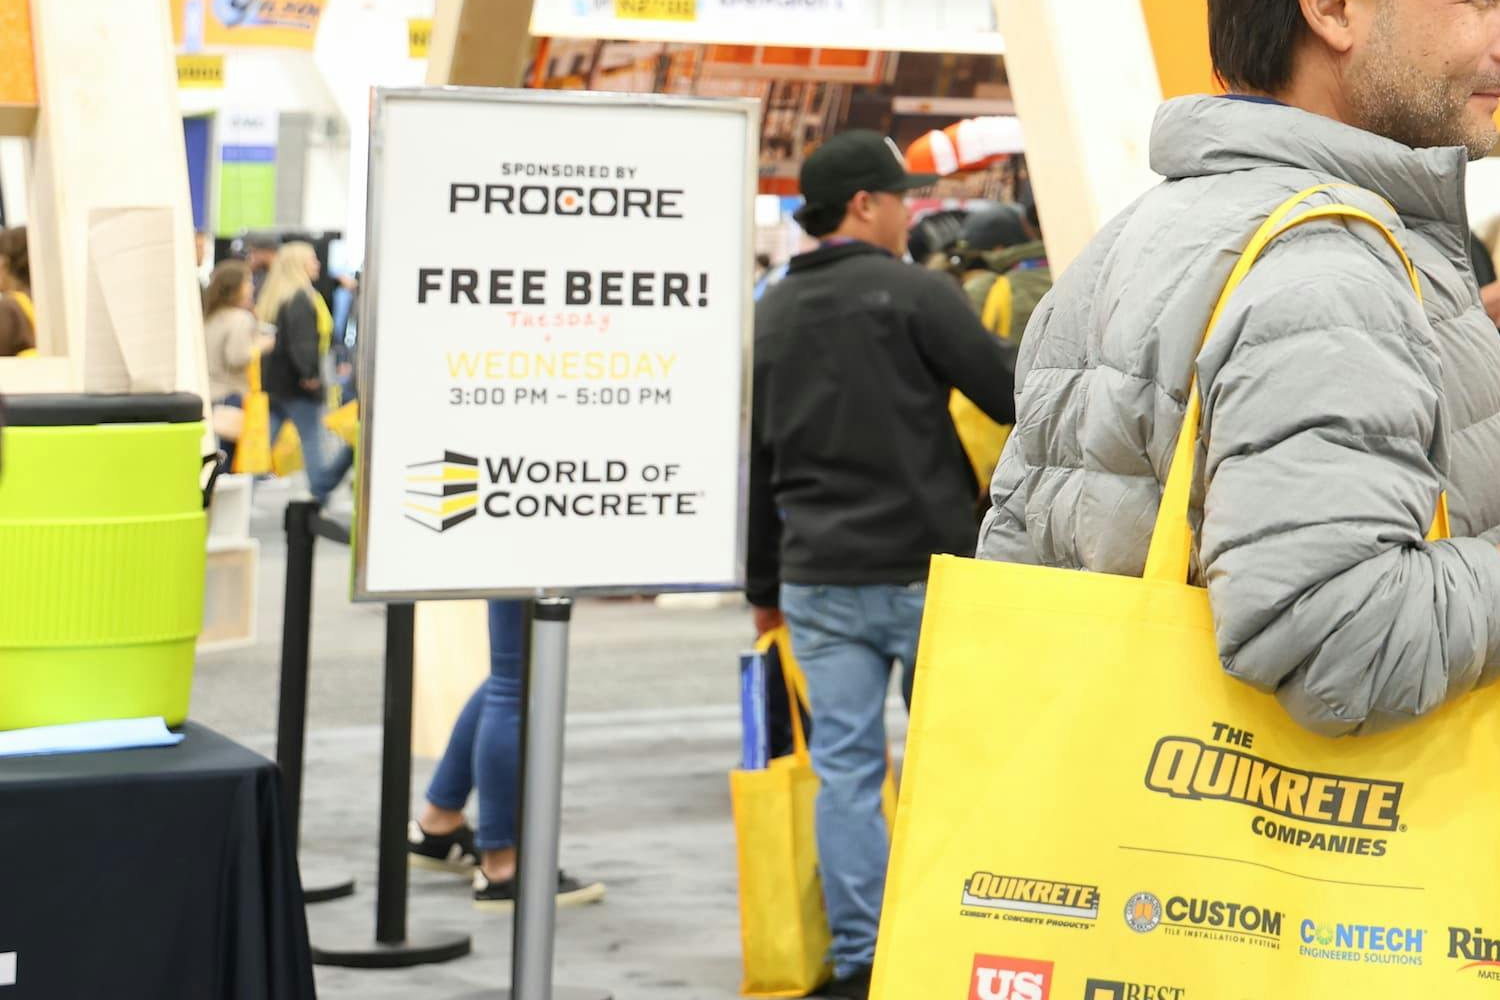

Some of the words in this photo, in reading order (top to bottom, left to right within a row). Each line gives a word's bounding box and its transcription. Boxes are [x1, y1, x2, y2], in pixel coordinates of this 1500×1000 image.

[502, 163, 610, 178] SPONSORED
[616, 166, 637, 179] BY
[449, 182, 684, 219] PROCORE
[417, 268, 547, 305] FREE
[565, 271, 709, 308] BEER!
[446, 352, 678, 380] WEDNESDAY
[449, 388, 505, 406] 3:00
[515, 389, 548, 405] PM
[576, 389, 631, 406] 5:00
[640, 390, 672, 405] PM
[485, 456, 628, 484] WORLD
[642, 464, 681, 483] OF
[483, 491, 699, 518] CONCRETE
[1211, 721, 1254, 749] THE
[1146, 737, 1403, 830] QUIKRETE
[1251, 815, 1388, 857] COMPANIES
[968, 872, 1094, 910] QUIKRETE
[960, 910, 992, 919] CEMENT
[994, 912, 1001, 920] &
[1002, 914, 1044, 925] CONCRETE
[1046, 919, 1090, 930] PRODUCTS
[1165, 896, 1281, 937] CUSTOM
[1164, 927, 1181, 936] TILE
[1184, 929, 1246, 944] INSTALLATION
[1248, 937, 1281, 950] SYSTEMS
[1300, 919, 1424, 953] CONTECH
[1299, 945, 1361, 962] ENGINEERED
[1363, 950, 1423, 966] SOLUTIONS
[976, 967, 1043, 1000] US
